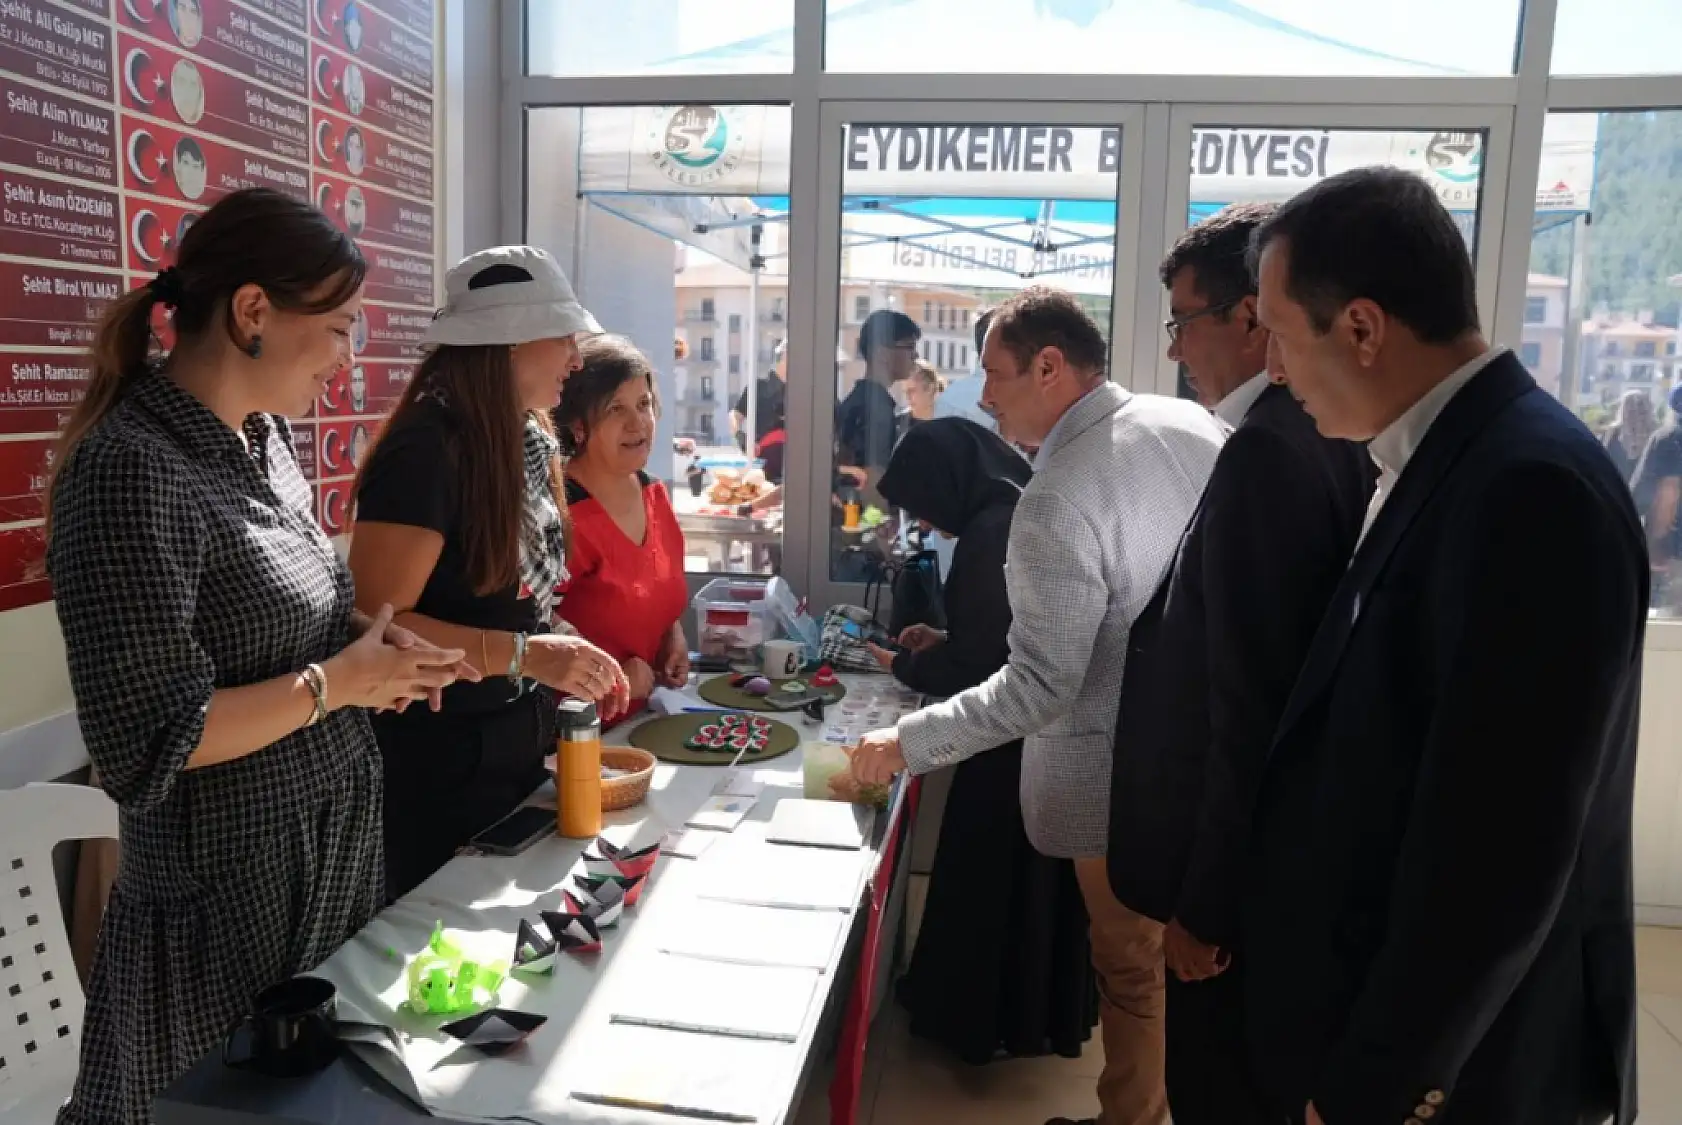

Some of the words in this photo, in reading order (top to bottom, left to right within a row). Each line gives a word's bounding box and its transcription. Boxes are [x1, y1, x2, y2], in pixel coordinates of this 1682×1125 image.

[36, 9, 51, 31] Ali
[53, 16, 82, 44] Galip
[82, 27, 104, 50] MET
[7, 90, 39, 116] Şehit
[42, 101, 68, 124] Alim
[68, 107, 109, 135] YILMAZ
[3, 181, 35, 204] Şehit
[38, 188, 66, 210] Asım
[66, 189, 114, 218] ÖZDEMİR
[70, 244, 100, 260] Temmuz
[22, 274, 52, 296] Şehit
[54, 278, 80, 297] Birol
[81, 281, 118, 300] YILMAZ
[11, 362, 42, 385] Şehit
